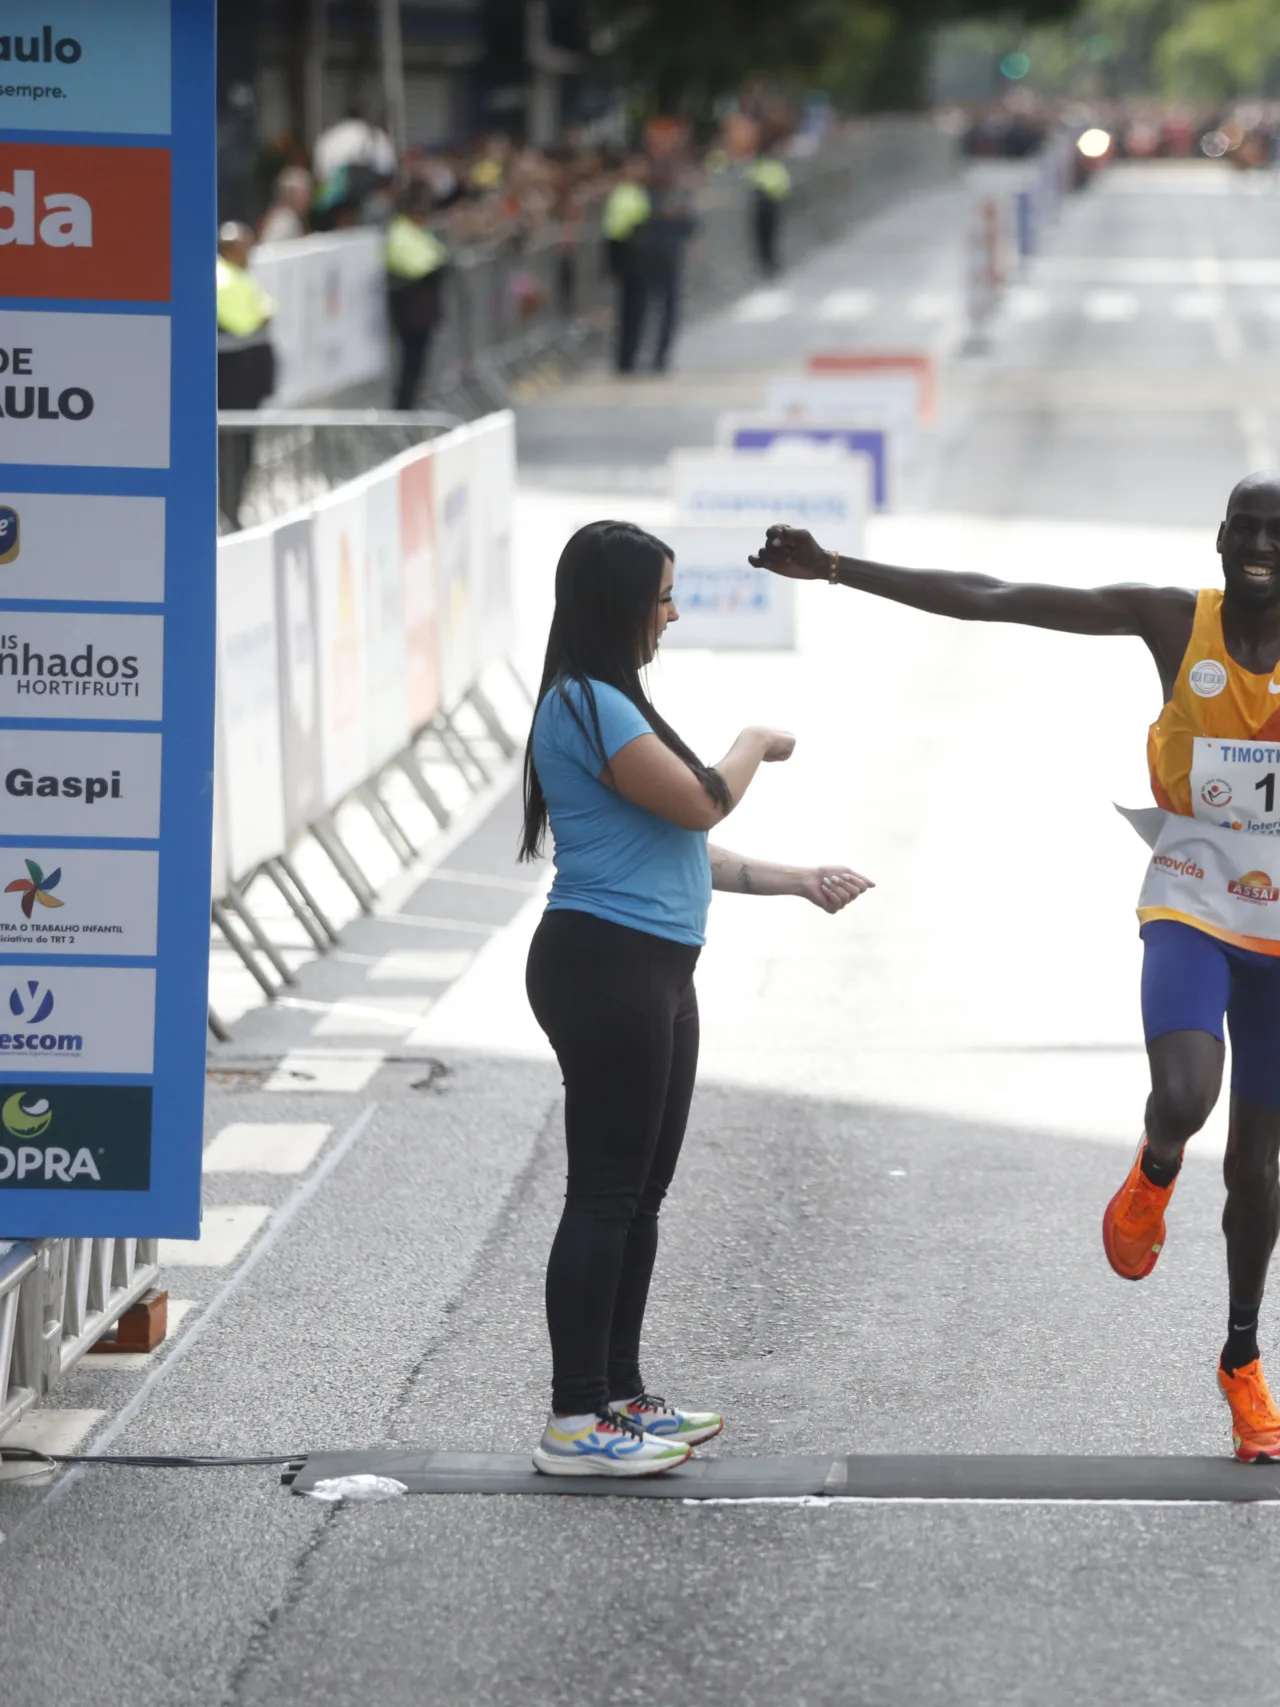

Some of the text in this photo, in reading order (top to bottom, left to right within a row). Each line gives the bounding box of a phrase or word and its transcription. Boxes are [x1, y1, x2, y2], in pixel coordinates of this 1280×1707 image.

[0, 169, 93, 248] da
[0, 386, 95, 421] ULO
[0, 642, 139, 679] nhados
[17, 679, 139, 697] HORTIFRUTI
[5, 768, 121, 804] Gaspi
[1255, 772, 1276, 813] 1
[1153, 855, 1205, 880] movida
[31, 924, 80, 933] TRABALHO
[82, 925, 124, 933] INFANTIL
[36, 935, 48, 943] do
[51, 936, 66, 944] TRT
[69, 936, 75, 944] 2
